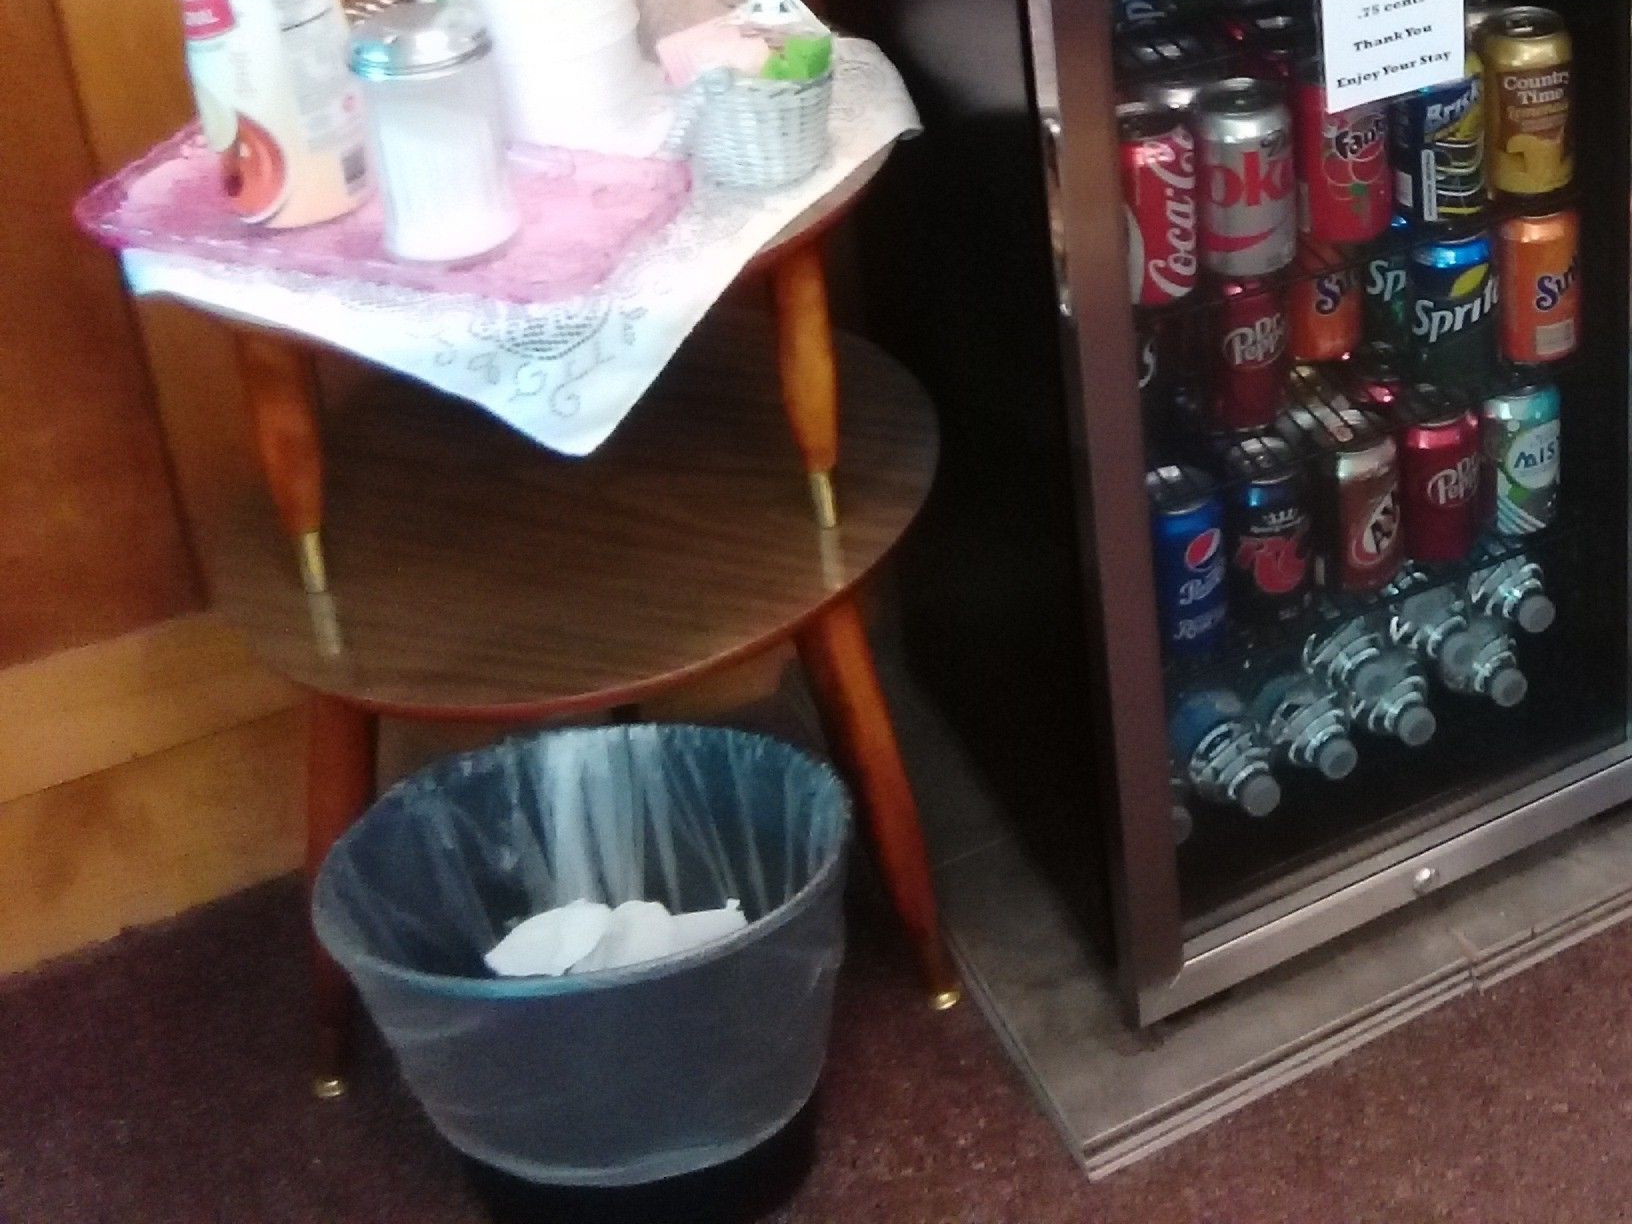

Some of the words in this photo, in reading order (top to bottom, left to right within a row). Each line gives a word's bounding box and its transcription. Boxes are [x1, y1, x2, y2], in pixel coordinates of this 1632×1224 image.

[1357, 4, 1380, 20] .75
[1353, 31, 1403, 52] Thank
[1404, 24, 1433, 39] You
[1336, 71, 1381, 88] Enjoy
[1382, 60, 1417, 75] Your
[1419, 50, 1452, 66] Stay
[1335, 117, 1385, 160] Fant
